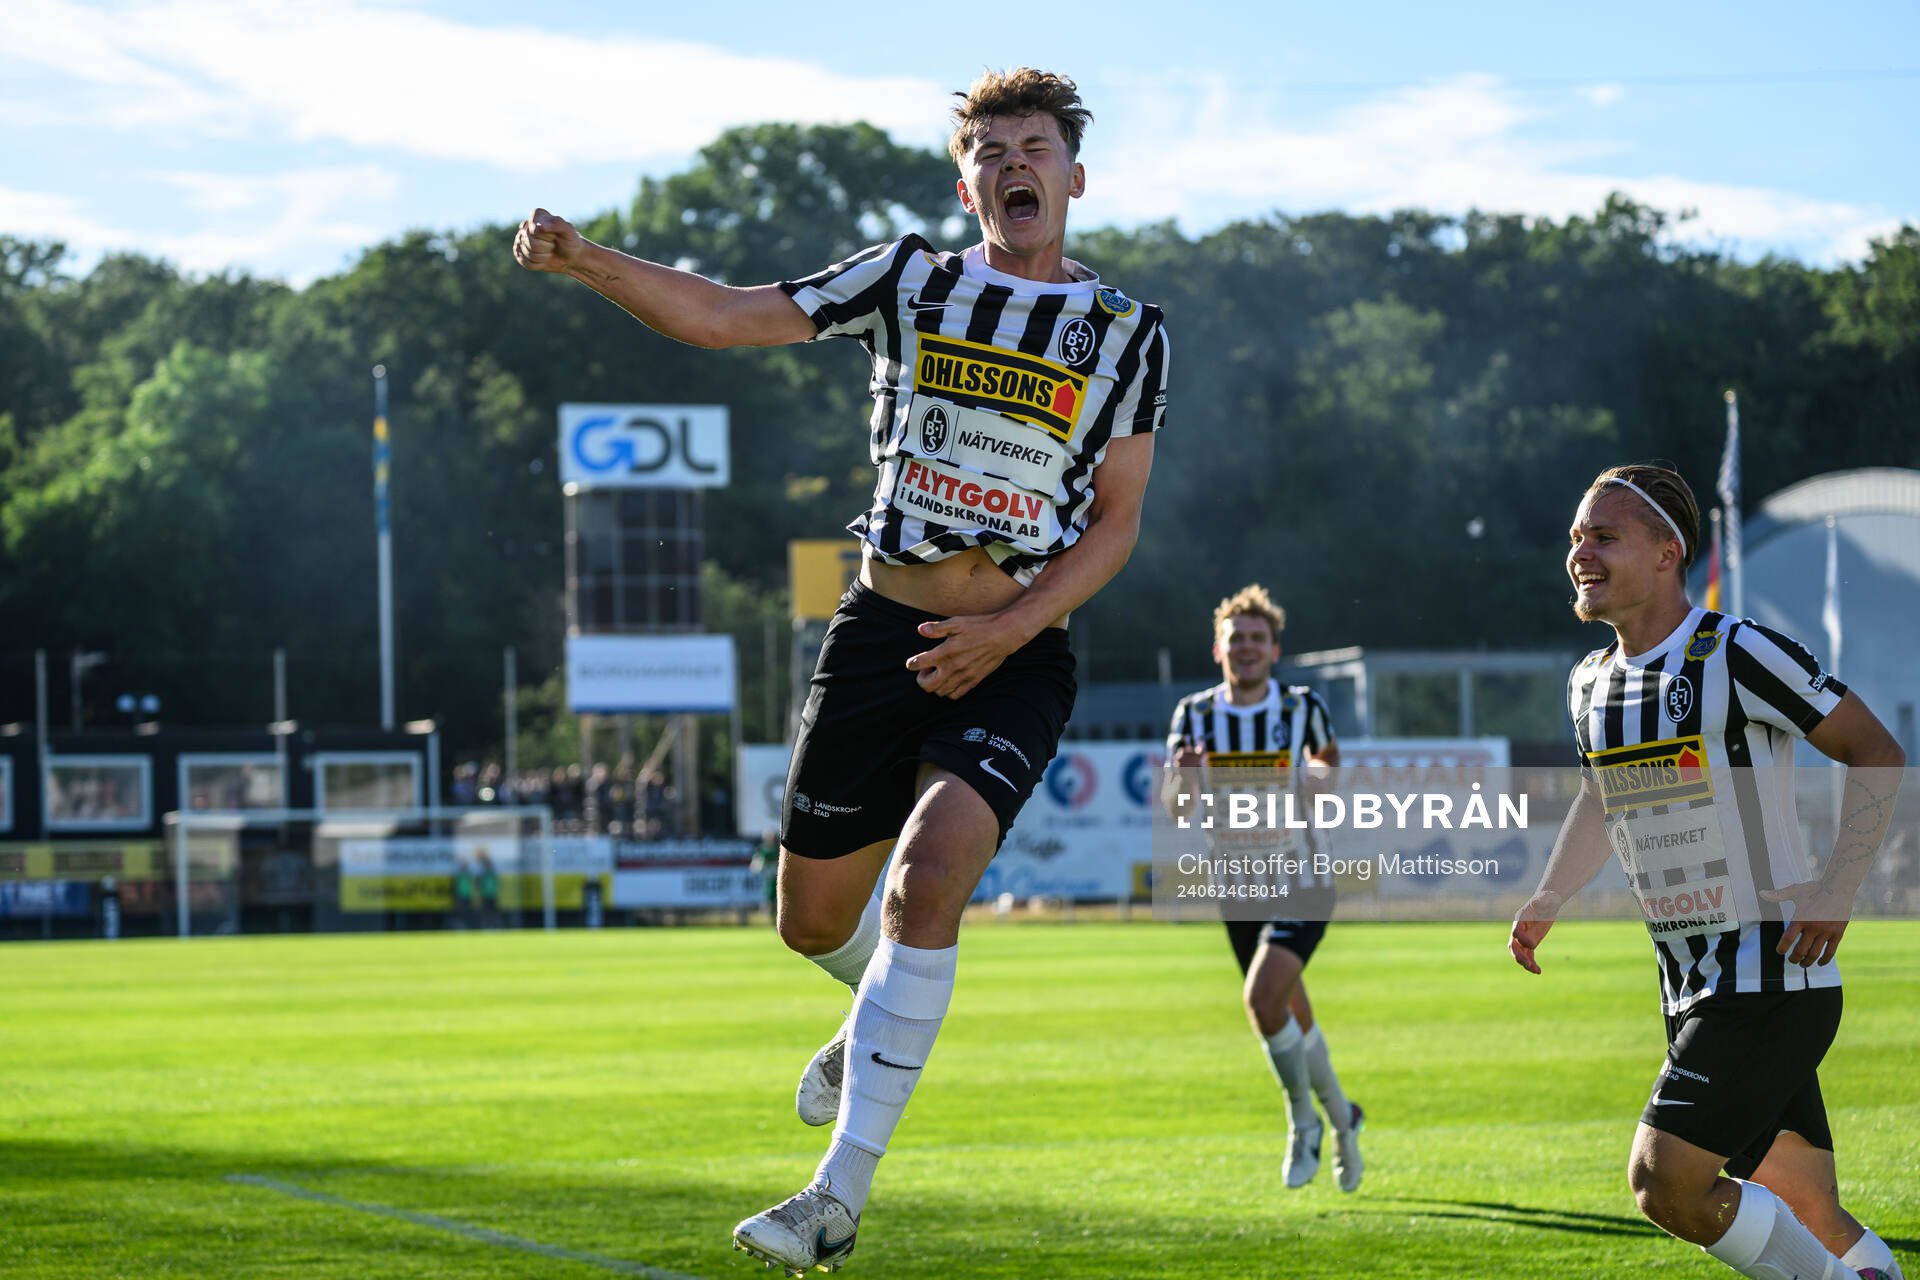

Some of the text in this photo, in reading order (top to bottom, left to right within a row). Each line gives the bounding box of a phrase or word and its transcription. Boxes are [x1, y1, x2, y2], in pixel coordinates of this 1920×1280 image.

[920, 354, 1054, 408] OHLSSONS
[572, 414, 717, 474] GDL
[957, 430, 1053, 468] NÄTVERKET
[904, 460, 1044, 522] FLYTGOLV
[907, 490, 1013, 534] LANDSKRONA
[1016, 523, 1041, 538] AB
[987, 739, 1007, 752] STAD
[813, 808, 830, 818] STAD
[1635, 827, 1707, 852] NÄTVERKET
[1643, 886, 1724, 919] TGOLV
[1709, 911, 1728, 925] AB
